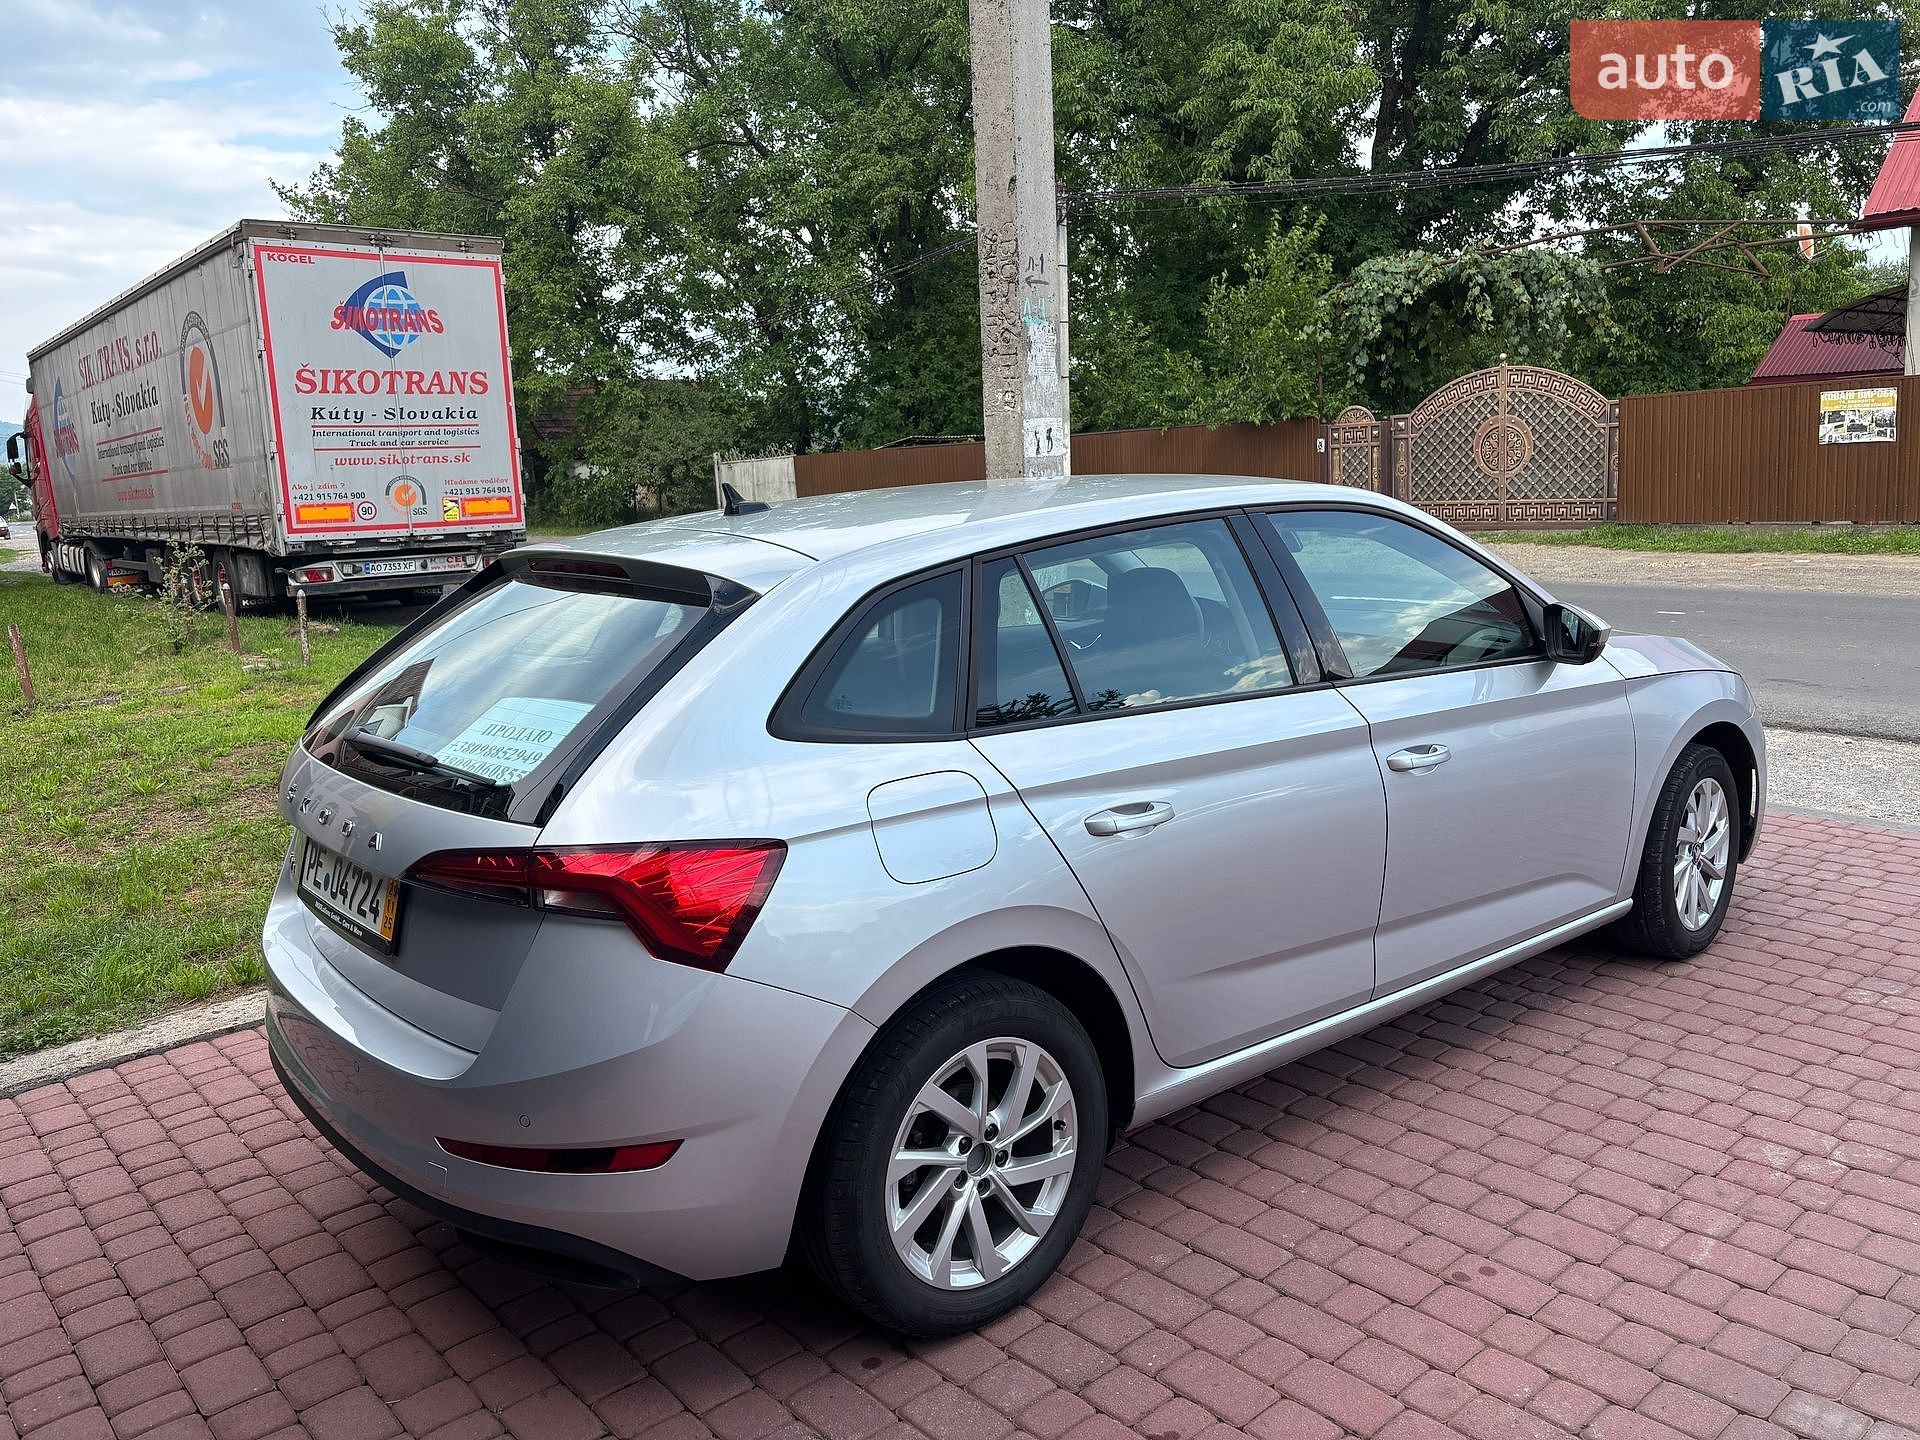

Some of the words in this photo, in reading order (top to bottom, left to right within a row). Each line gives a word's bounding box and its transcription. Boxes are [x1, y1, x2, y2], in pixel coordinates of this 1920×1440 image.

[330, 300, 445, 334] ŠIKOTRANS
[294, 362, 489, 395] ŠIKOTRANS
[91, 398, 111, 428] Kúty
[115, 379, 158, 418] Slovakia
[310, 406, 365, 424] Kúty
[384, 406, 479, 420] Slovakia
[312, 429, 376, 437] International
[378, 429, 421, 438] transport
[443, 427, 480, 437] logistics
[349, 439, 378, 447] Truck
[380, 439, 398, 447] and
[418, 438, 449, 446] service
[335, 452, 472, 466] www.sikotrans.sk
[293, 493, 313, 501] +421
[350, 491, 366, 499] 900
[444, 488, 463, 496] +421
[465, 487, 480, 495] 915
[482, 486, 496, 494] 764
[496, 486, 511, 494] 901
[361, 506, 373, 516] 90
[412, 507, 428, 516] SGS
[370, 563, 383, 573] AO
[383, 562, 402, 571] 7353
[403, 561, 414, 570] XF
[481, 723, 553, 744] ПРОДАЮ
[330, 855, 384, 924] 04724
